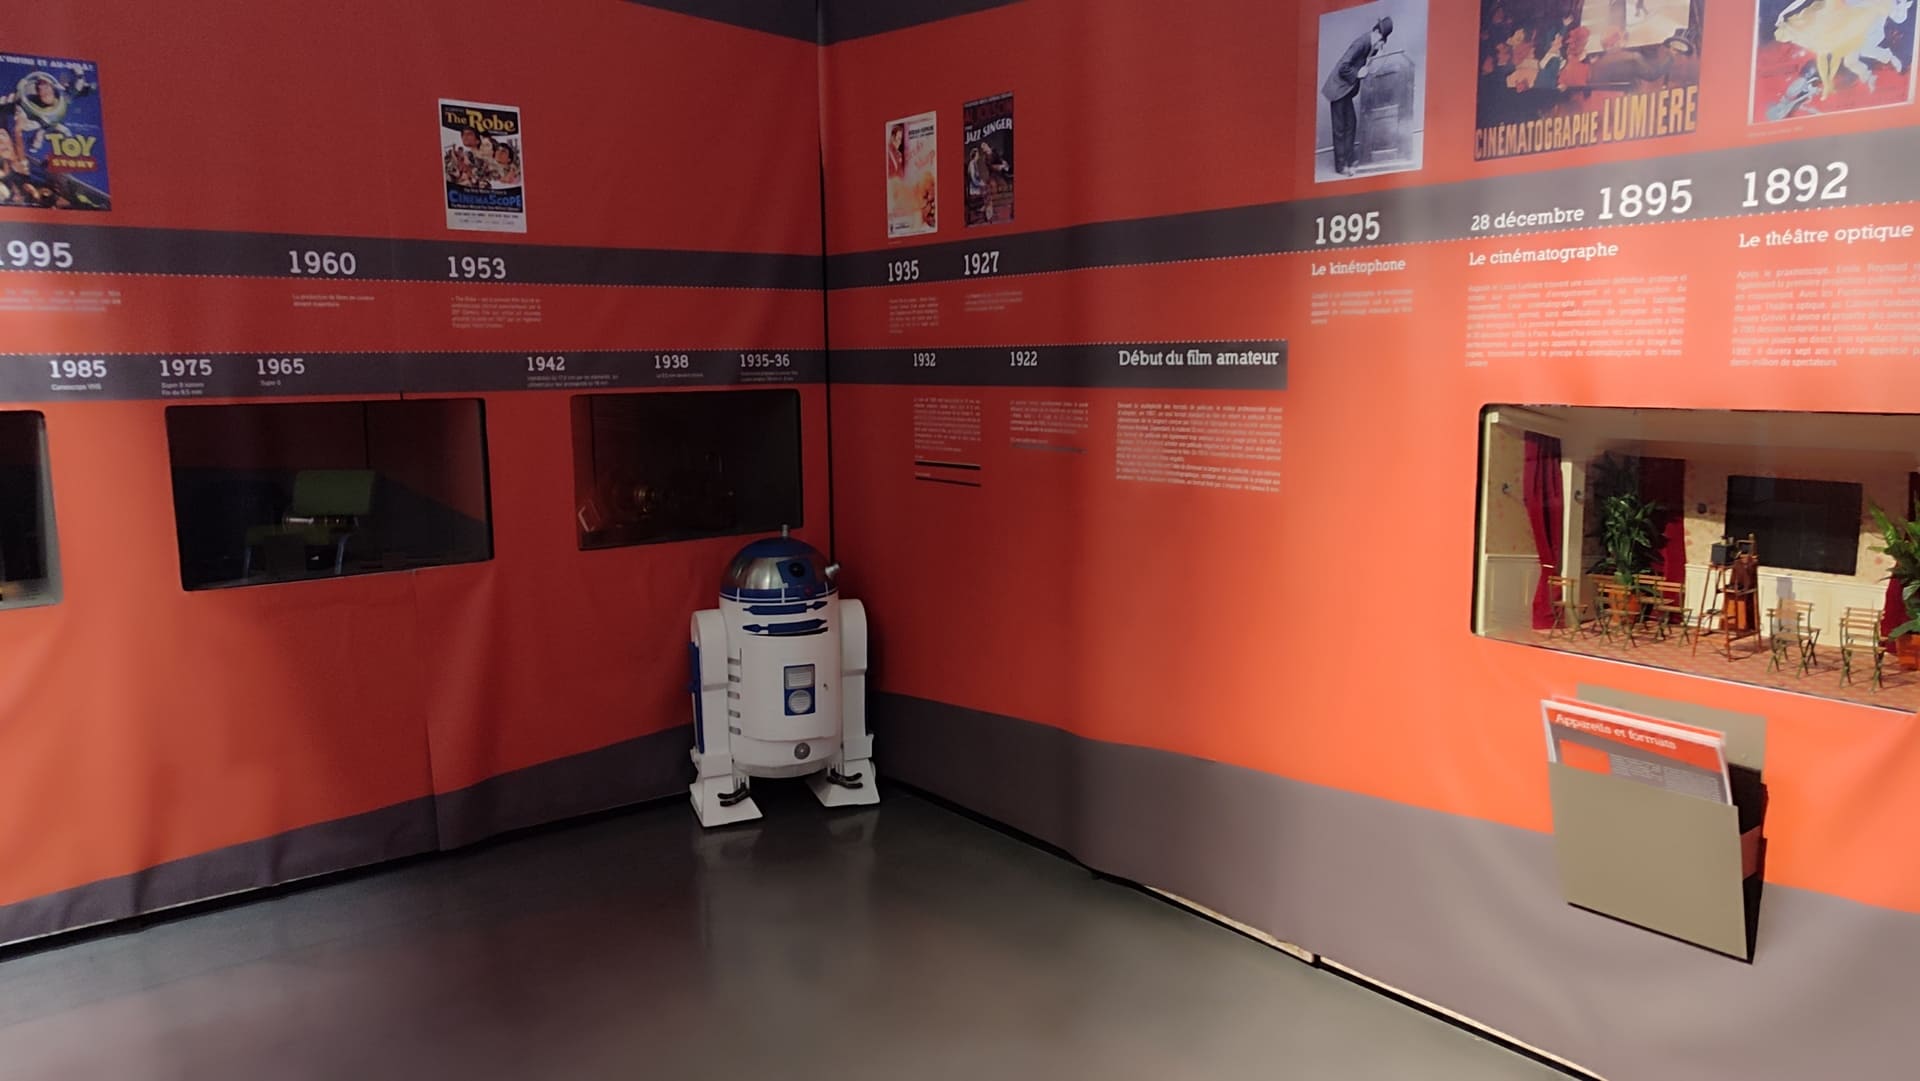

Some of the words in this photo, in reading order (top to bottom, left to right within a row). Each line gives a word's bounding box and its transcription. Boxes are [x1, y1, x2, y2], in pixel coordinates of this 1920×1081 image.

[445, 111, 467, 124] The
[466, 110, 516, 133] Robe
[964, 128, 982, 145] JAZZ
[982, 117, 1013, 137] SINGER
[1475, 110, 1599, 160] CINÉMATOGRAPHE
[1602, 84, 1698, 142] LUMIÈRE
[45, 132, 97, 158] TOY
[53, 159, 96, 169] STORY
[1742, 161, 1849, 208] 1892
[1470, 214, 1490, 231] 28
[1494, 206, 1585, 229] décembre
[1598, 178, 1693, 220] 1895
[1315, 210, 1381, 245] 1895
[1738, 233, 1761, 248] Le
[1766, 229, 1829, 246] théâtre
[1834, 223, 1914, 244] optique
[0, 239, 74, 268] 995
[289, 250, 357, 275] 1960
[963, 250, 1000, 276] 1927
[1469, 251, 1487, 266] Le
[1489, 241, 1619, 263] cinématographe
[448, 256, 507, 280] 1953
[888, 259, 920, 283] 1935
[1312, 263, 1327, 276] Le
[1329, 258, 1406, 276] kinétophone
[49, 359, 108, 378] 1985
[160, 358, 213, 377] 1975
[257, 358, 305, 375] 1965
[527, 356, 566, 372] 1942
[654, 354, 689, 369] 1938
[739, 353, 791, 368] 1935-36
[913, 352, 936, 367] 1932
[1010, 351, 1038, 367] 1922
[1118, 349, 1164, 366] Début
[1165, 349, 1185, 366] du
[1186, 349, 1213, 366] film
[1216, 350, 1280, 366] amateur
[1614, 728, 1627, 738] et
[1627, 729, 1678, 750] formats
